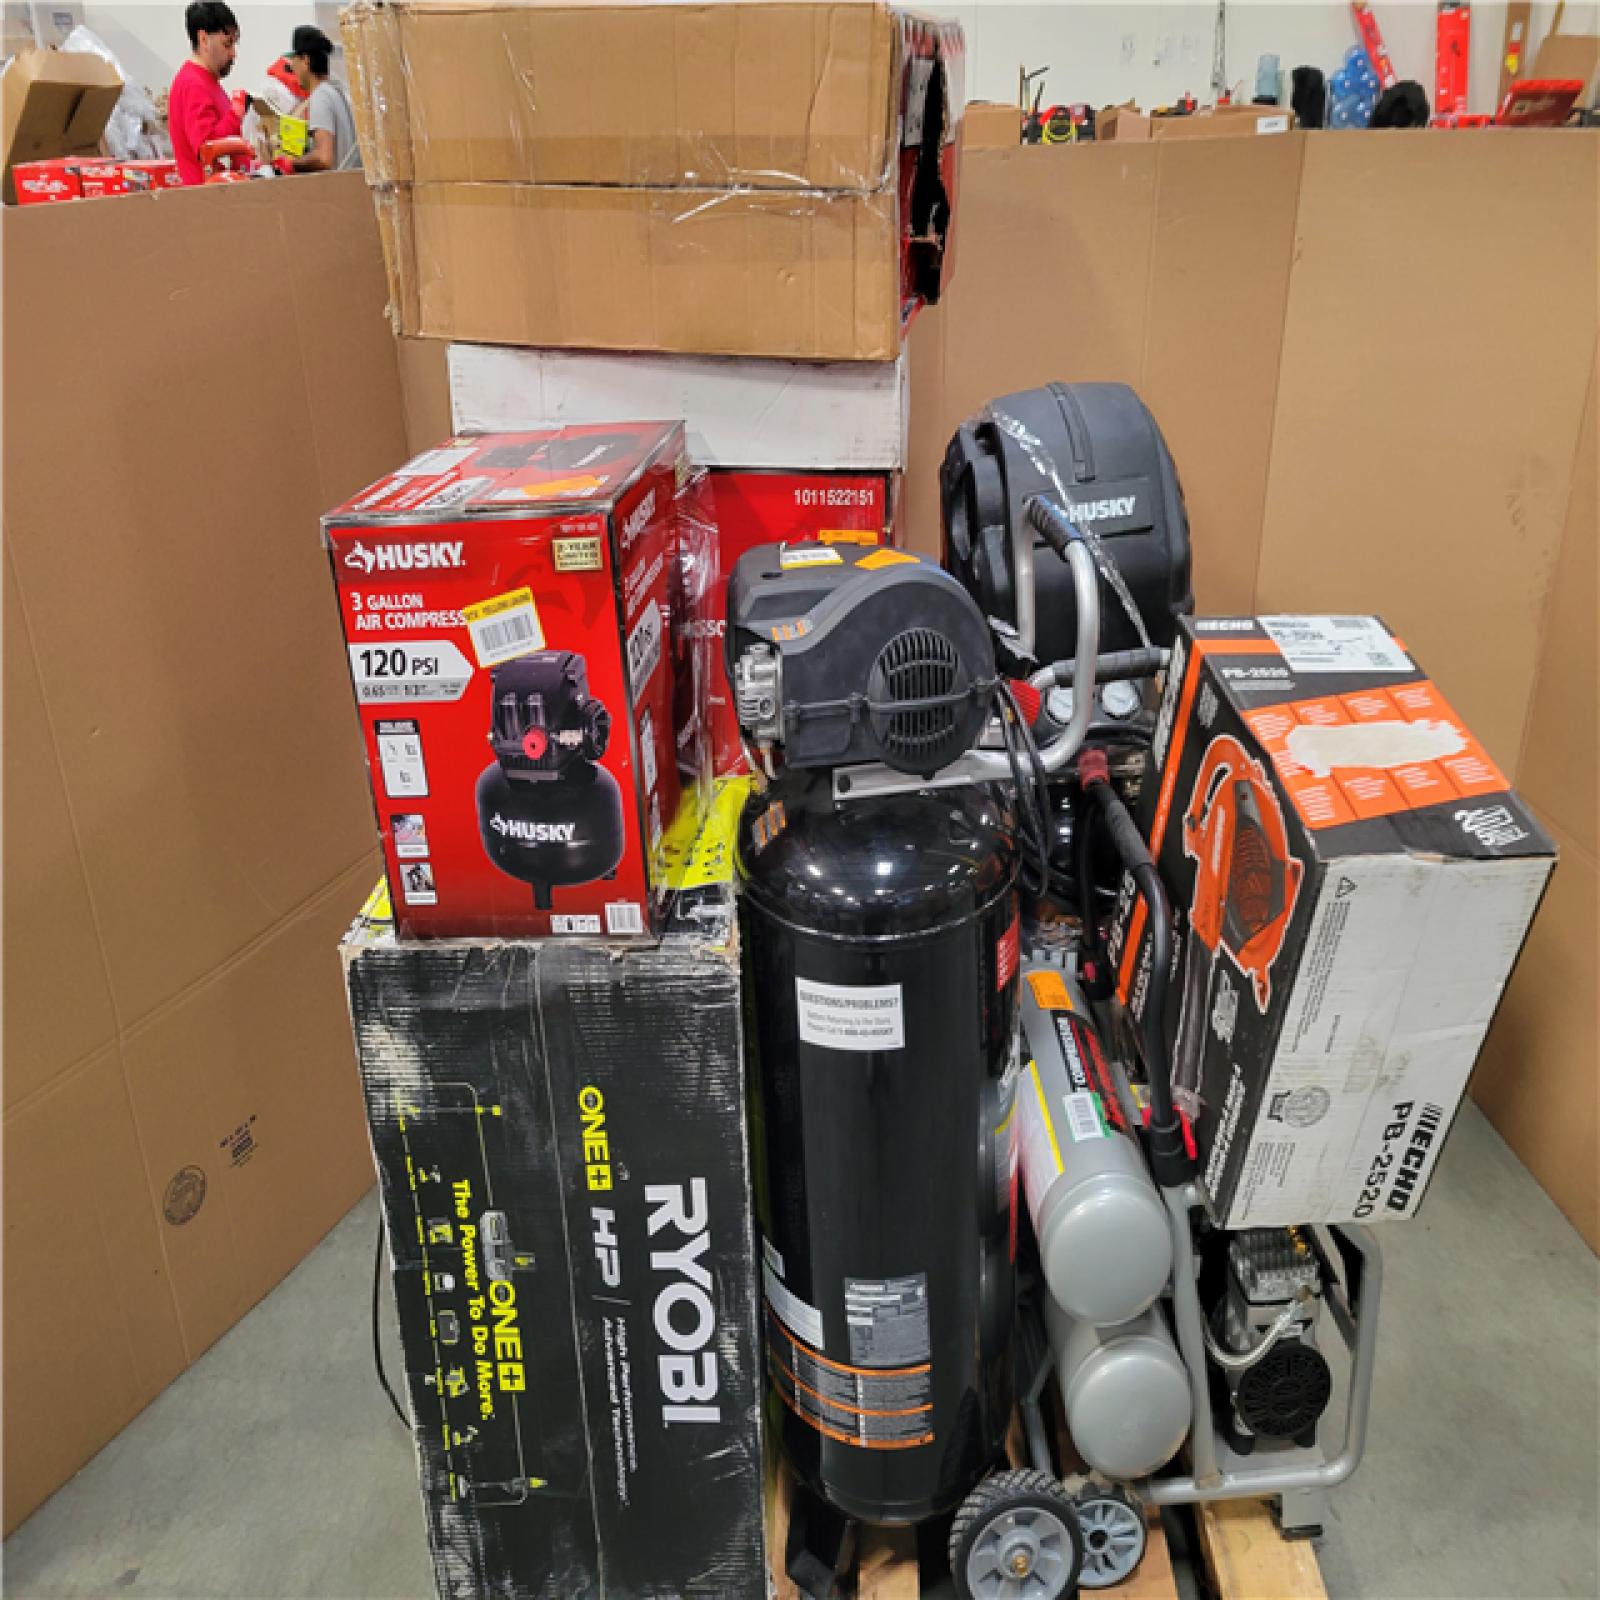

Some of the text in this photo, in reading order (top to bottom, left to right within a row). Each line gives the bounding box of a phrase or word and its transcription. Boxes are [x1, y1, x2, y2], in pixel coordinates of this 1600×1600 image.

[794, 489, 874, 505] 1011522151
[1069, 495, 1136, 523] HUSKY
[377, 541, 464, 570] HUSKY
[351, 592, 424, 610] 3 GALLON
[355, 613, 382, 630] AIR
[360, 649, 438, 677] 120 PSI
[509, 822, 575, 841] HUSKY
[1353, 1100, 1415, 1218] PB-2520
[1387, 1120, 1437, 1213] ECHO
[452, 1179, 473, 1219] The
[459, 1224, 481, 1291] Power
[591, 1207, 621, 1287] HP
[468, 1295, 486, 1321] To
[644, 1177, 721, 1423] RYOBI
[472, 1325, 489, 1356] Do
[602, 1316, 631, 1504] Advanced Technology
[616, 1317, 639, 1473] High Performance
